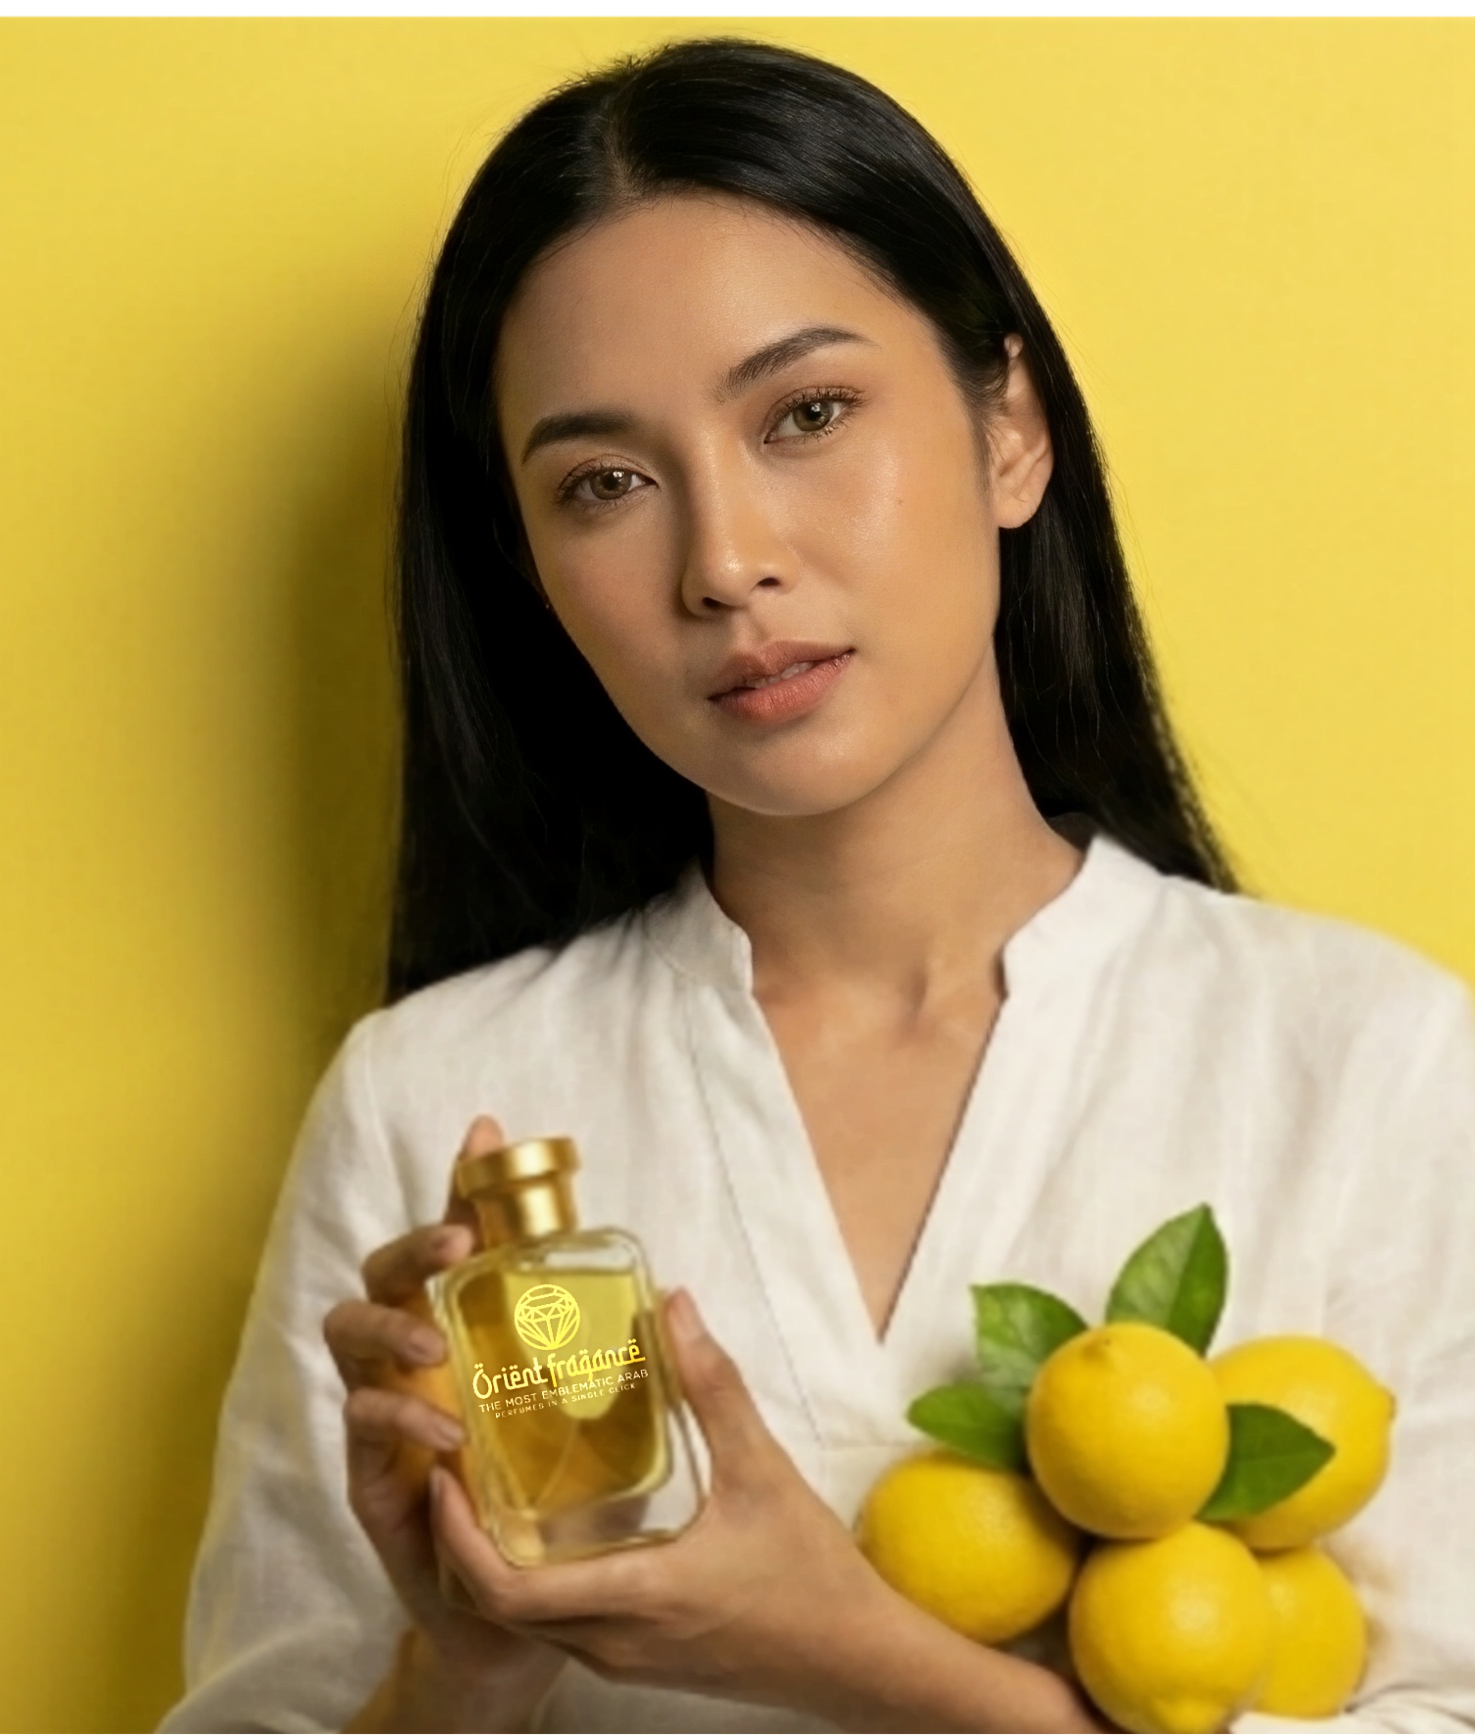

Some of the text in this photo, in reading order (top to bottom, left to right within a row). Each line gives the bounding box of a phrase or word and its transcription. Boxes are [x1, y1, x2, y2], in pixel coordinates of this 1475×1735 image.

[478, 1368, 649, 1413] THE MOST EMBLEMATIC ARAB
[571, 1389, 605, 1402] SINGLE
[608, 1382, 636, 1395] CLICK
